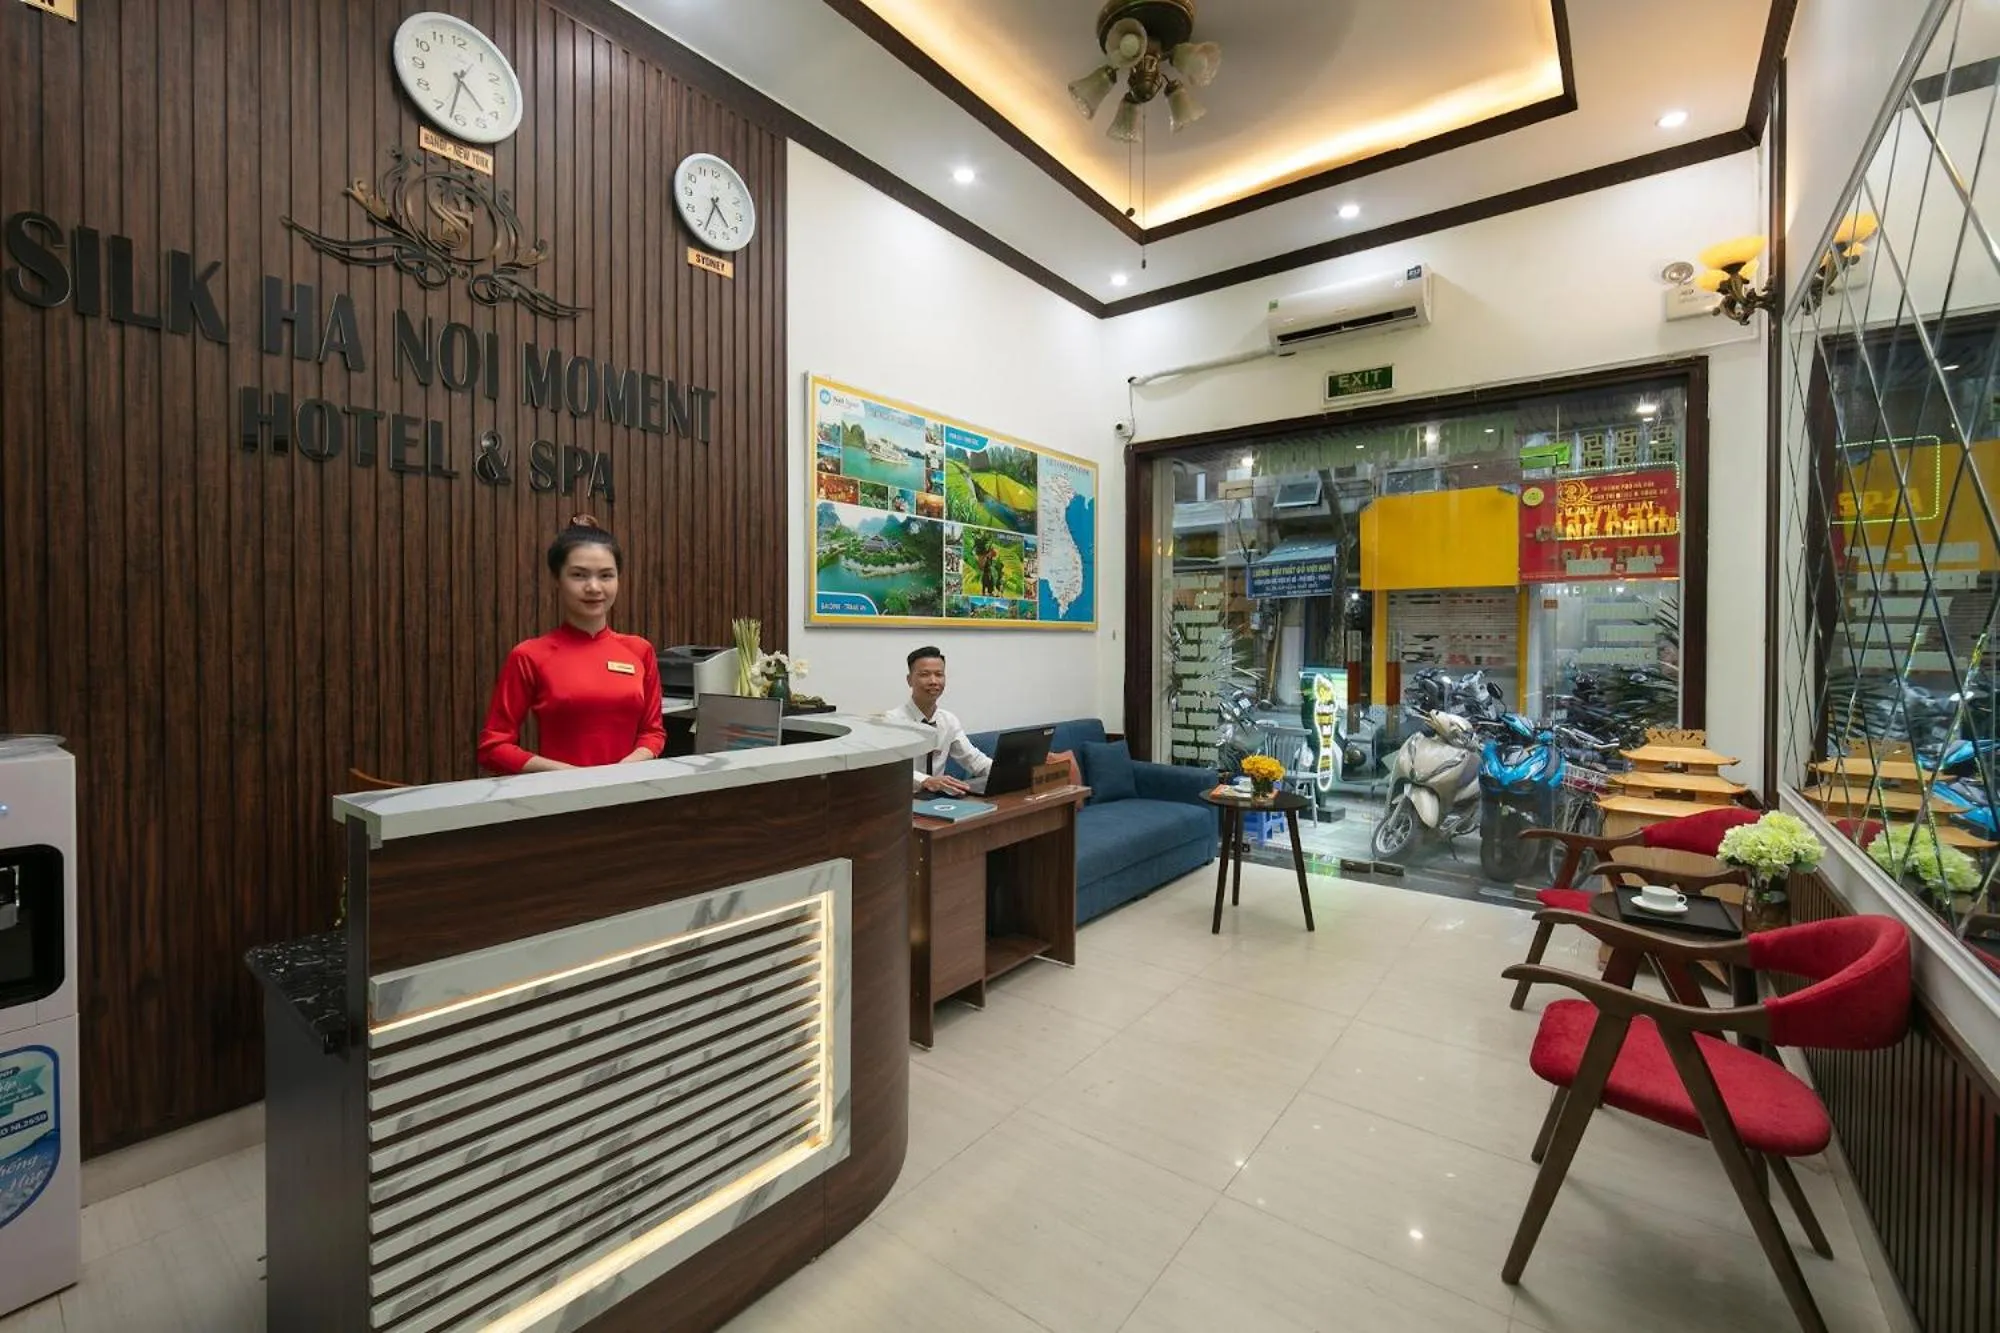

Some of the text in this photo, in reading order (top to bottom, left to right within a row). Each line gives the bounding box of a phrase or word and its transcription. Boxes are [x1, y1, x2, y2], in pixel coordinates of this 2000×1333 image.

[415, 38, 431, 52] 10
[431, 31, 444, 45] 11
[451, 35, 467, 50] 12
[412, 56, 425, 69] 9
[416, 78, 431, 92] 8
[488, 72, 500, 86] 2
[433, 99, 445, 111] 7
[454, 114, 467, 128] 6
[454, 144, 470, 161] NEW
[472, 151, 490, 171] YORK
[711, 168, 721, 179] 12
[695, 253, 725, 271] SYDNEY
[3, 210, 717, 445] SILK HA NOI MOMENT
[1338, 369, 1383, 388] EXIT
[240, 385, 615, 503] HOTEL & SPA
